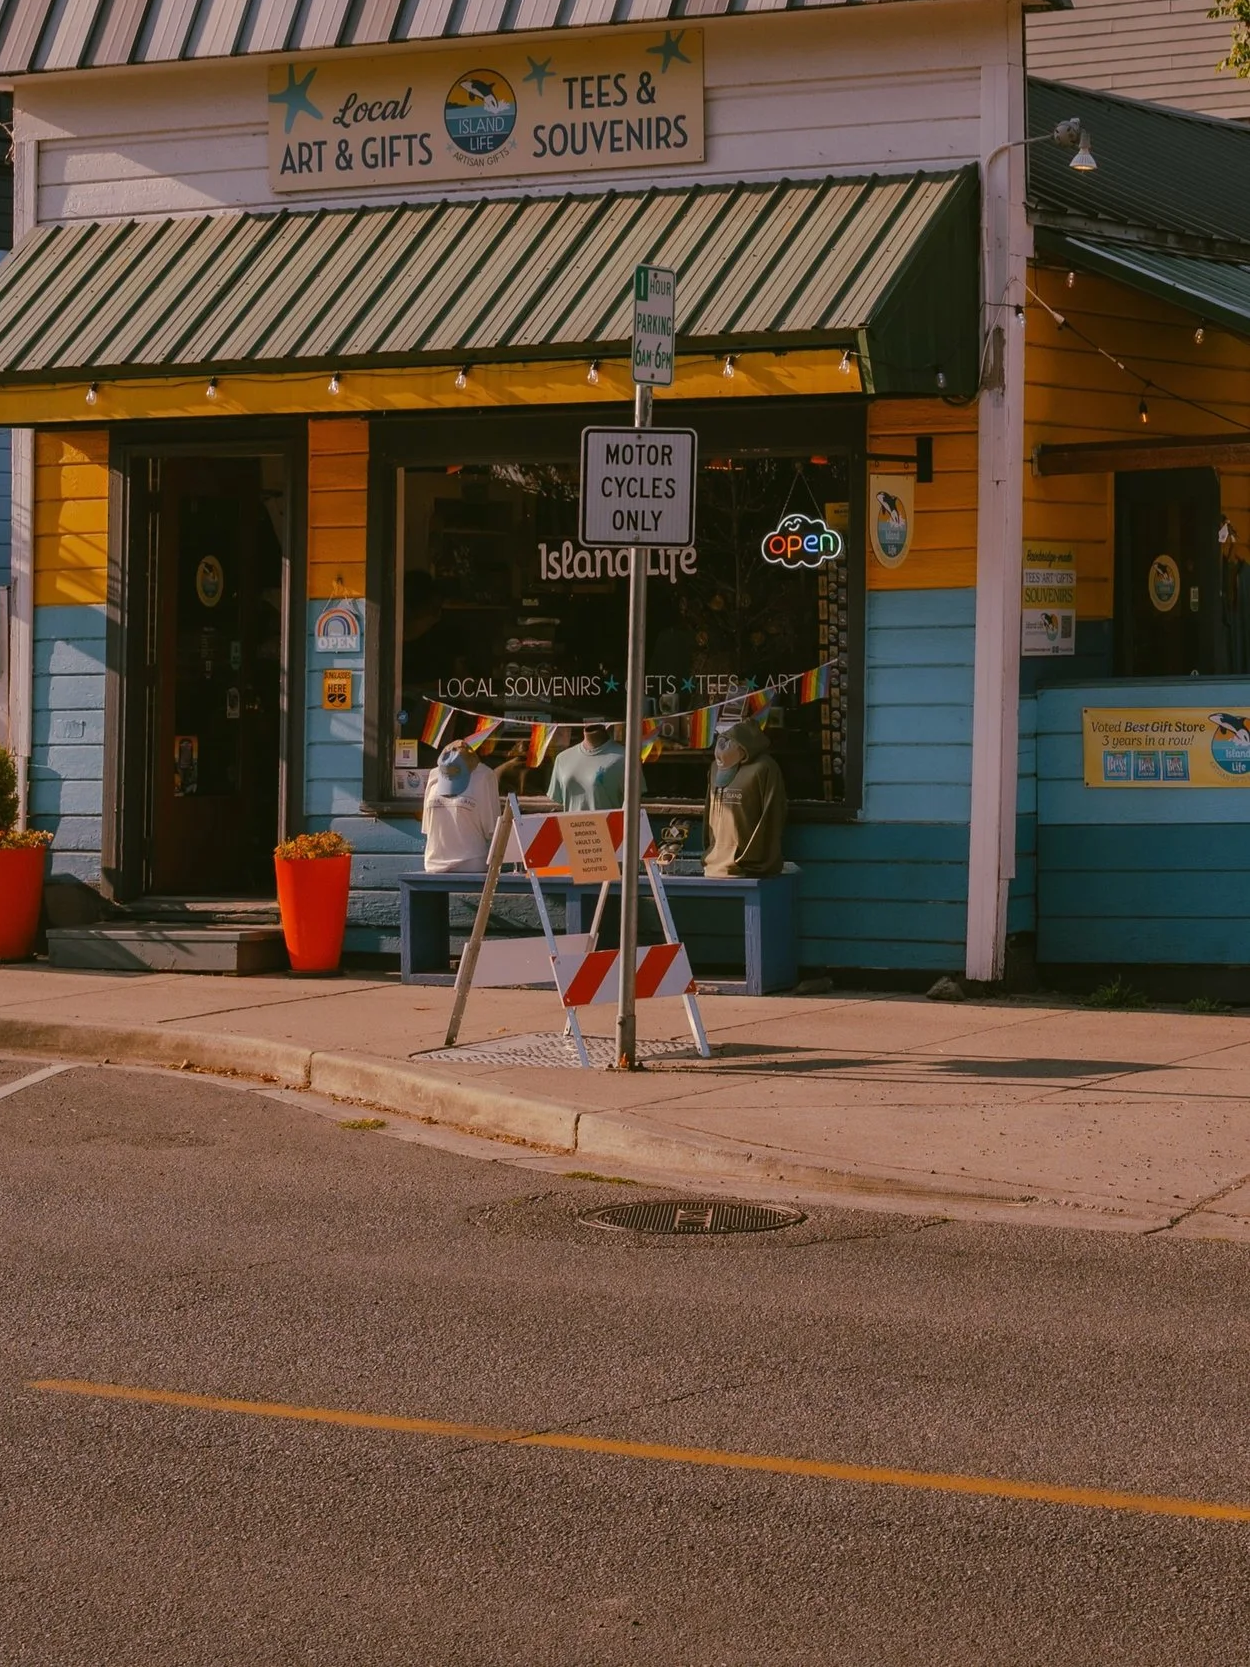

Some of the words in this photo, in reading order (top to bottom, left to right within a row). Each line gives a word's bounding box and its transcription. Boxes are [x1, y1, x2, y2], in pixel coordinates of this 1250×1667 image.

[562, 73, 627, 110] TEES
[636, 71, 656, 105] &
[331, 87, 413, 129] Local
[458, 116, 505, 135] ISLAND
[532, 115, 689, 158] SOUVENIRS
[279, 141, 327, 175] ART
[334, 138, 353, 171] &
[360, 132, 433, 169] GIFTS
[469, 135, 495, 151] LIFE
[452, 151, 485, 168] ARTISAN
[486, 146, 510, 166] GIFTS
[639, 271, 645, 297] 1
[649, 279, 672, 296] HOUR
[636, 312, 672, 337] PARKING
[605, 443, 673, 466] MOTOR
[601, 476, 676, 499] CYCLES
[612, 509, 663, 531] ONLY
[769, 533, 834, 559] open
[1025, 588, 1073, 603] SOUVENIRS
[317, 635, 358, 650] OPEN
[327, 683, 347, 693] HERE
[438, 677, 498, 698] LOCAL
[504, 675, 601, 697] SOUVENIRS
[625, 674, 677, 695] FTS
[694, 674, 739, 695] TEES
[763, 673, 801, 695] ART
[1091, 721, 1122, 733] Voted
[1124, 721, 1150, 733] Best
[1150, 721, 1173, 734] Gift
[1174, 721, 1206, 733] Store
[1101, 735, 1110, 746] 3
[1112, 735, 1143, 749] years
[1145, 734, 1156, 746] in
[1157, 737, 1166, 746] a
[1167, 734, 1195, 746] row!
[1231, 761, 1247, 774] Life
